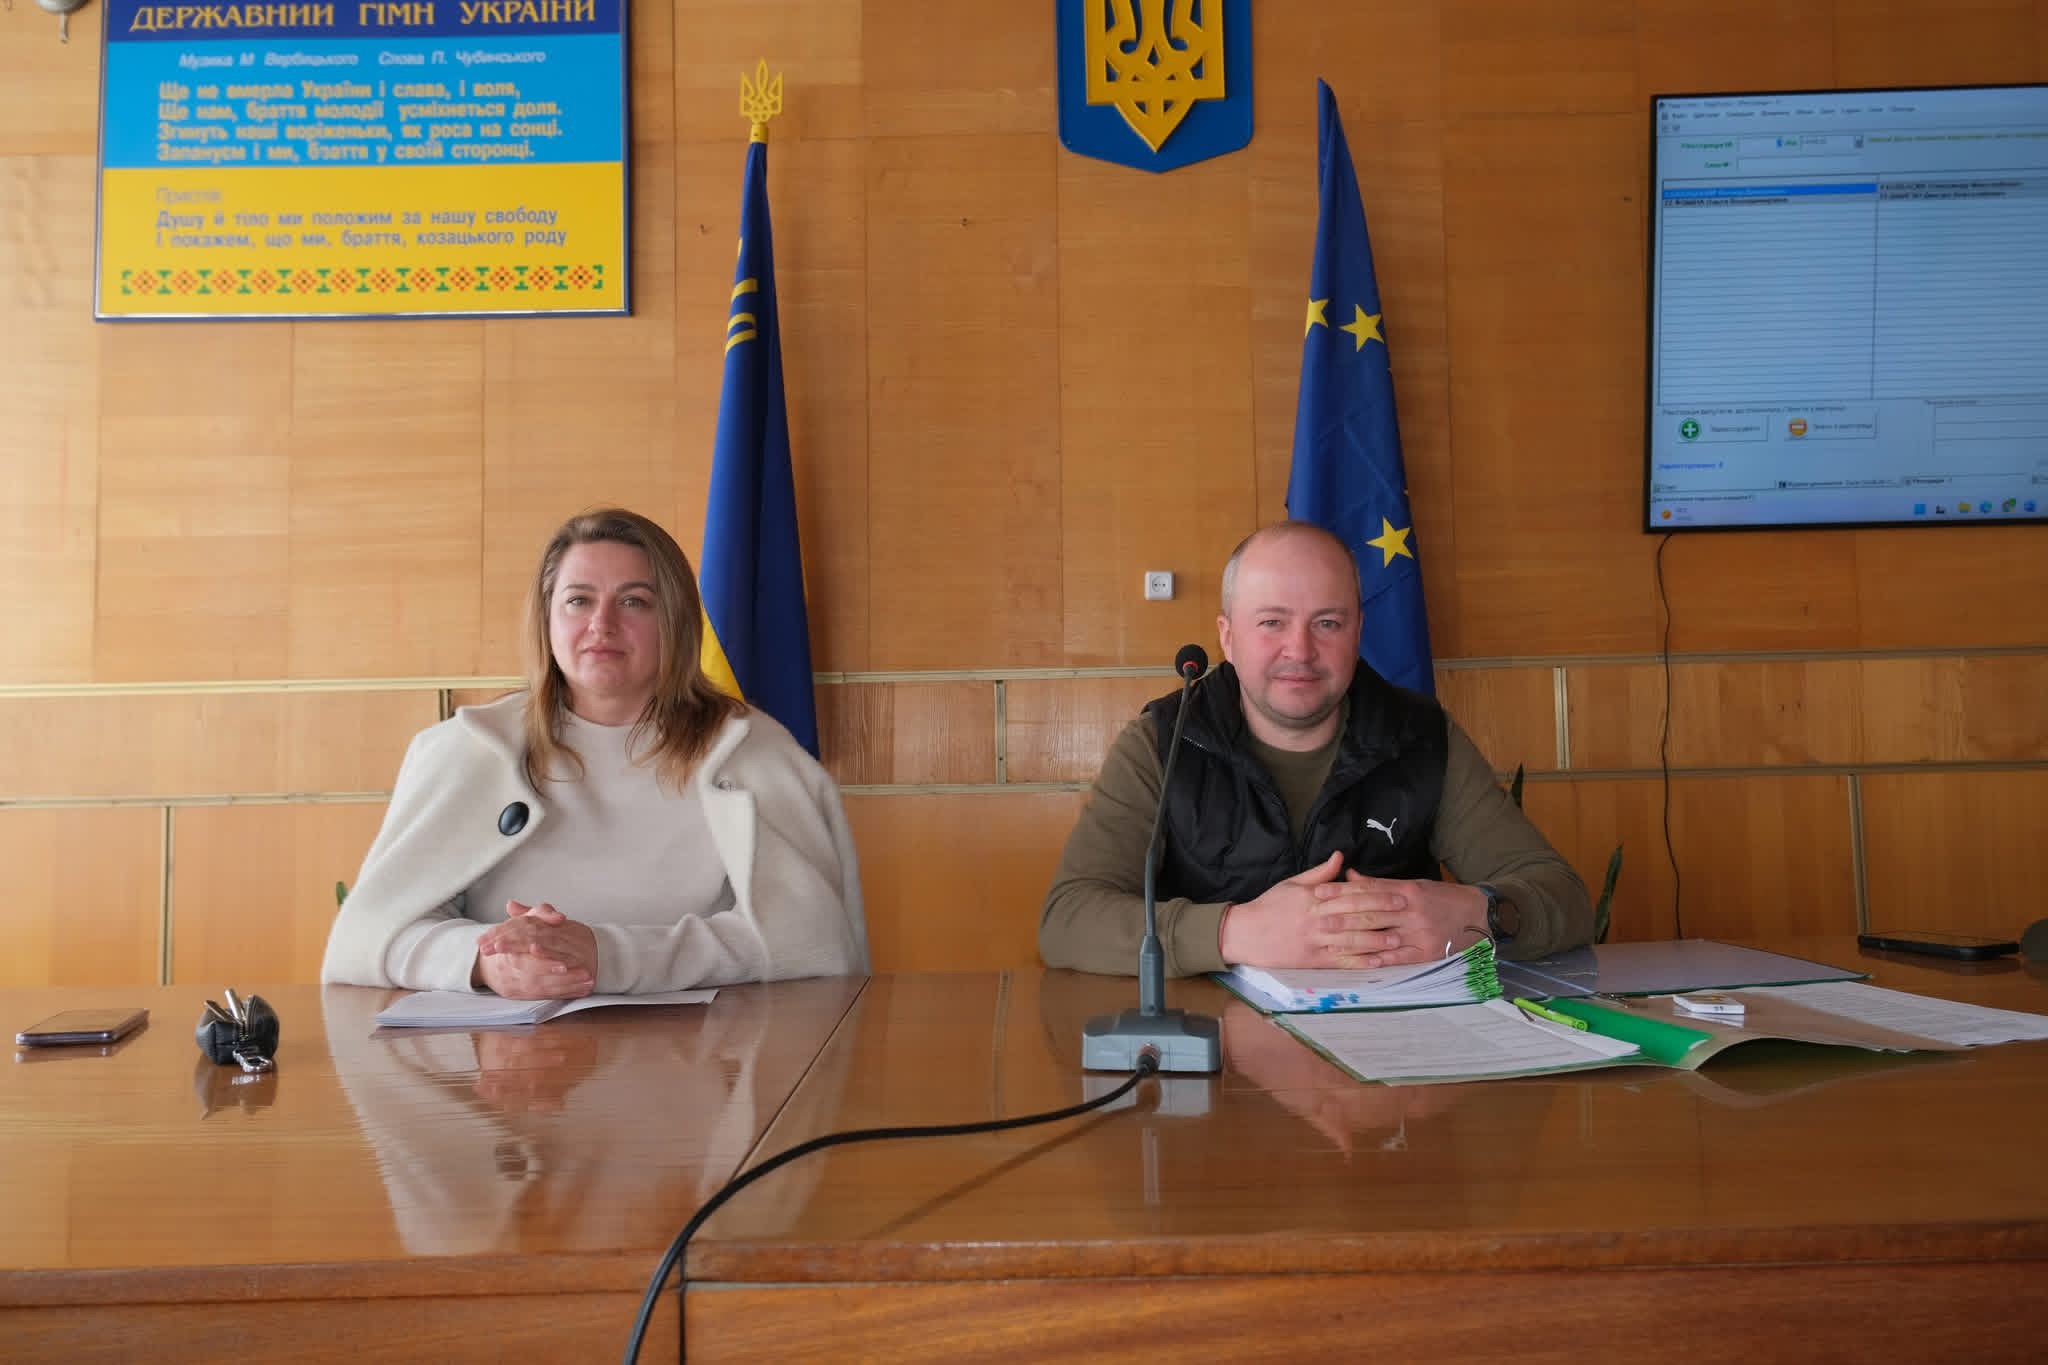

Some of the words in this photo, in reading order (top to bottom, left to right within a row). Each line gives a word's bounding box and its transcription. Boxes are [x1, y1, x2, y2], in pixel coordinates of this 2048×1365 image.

[358, 2, 435, 26] ГІМН
[473, 82, 521, 99] воля,
[246, 101, 308, 120] браття
[398, 101, 505, 121] усміхнеться
[512, 101, 563, 119] доля.
[402, 125, 422, 138] як
[430, 124, 473, 141] роса
[480, 124, 502, 137] на
[510, 118, 563, 138] сонці.
[376, 144, 387, 162] у
[395, 140, 443, 158] своїй
[452, 140, 535, 161] сторонці.
[155, 209, 206, 230] Душу
[234, 210, 270, 227] тіло
[278, 213, 304, 227] ми
[311, 211, 393, 226] положим
[402, 210, 422, 226] за
[430, 209, 477, 228] нашу
[484, 205, 558, 227] свободу
[169, 233, 256, 249] покажем,
[265, 232, 293, 248] що
[341, 228, 407, 249] браття,
[417, 228, 514, 247] козацького
[524, 228, 567, 247] роду
